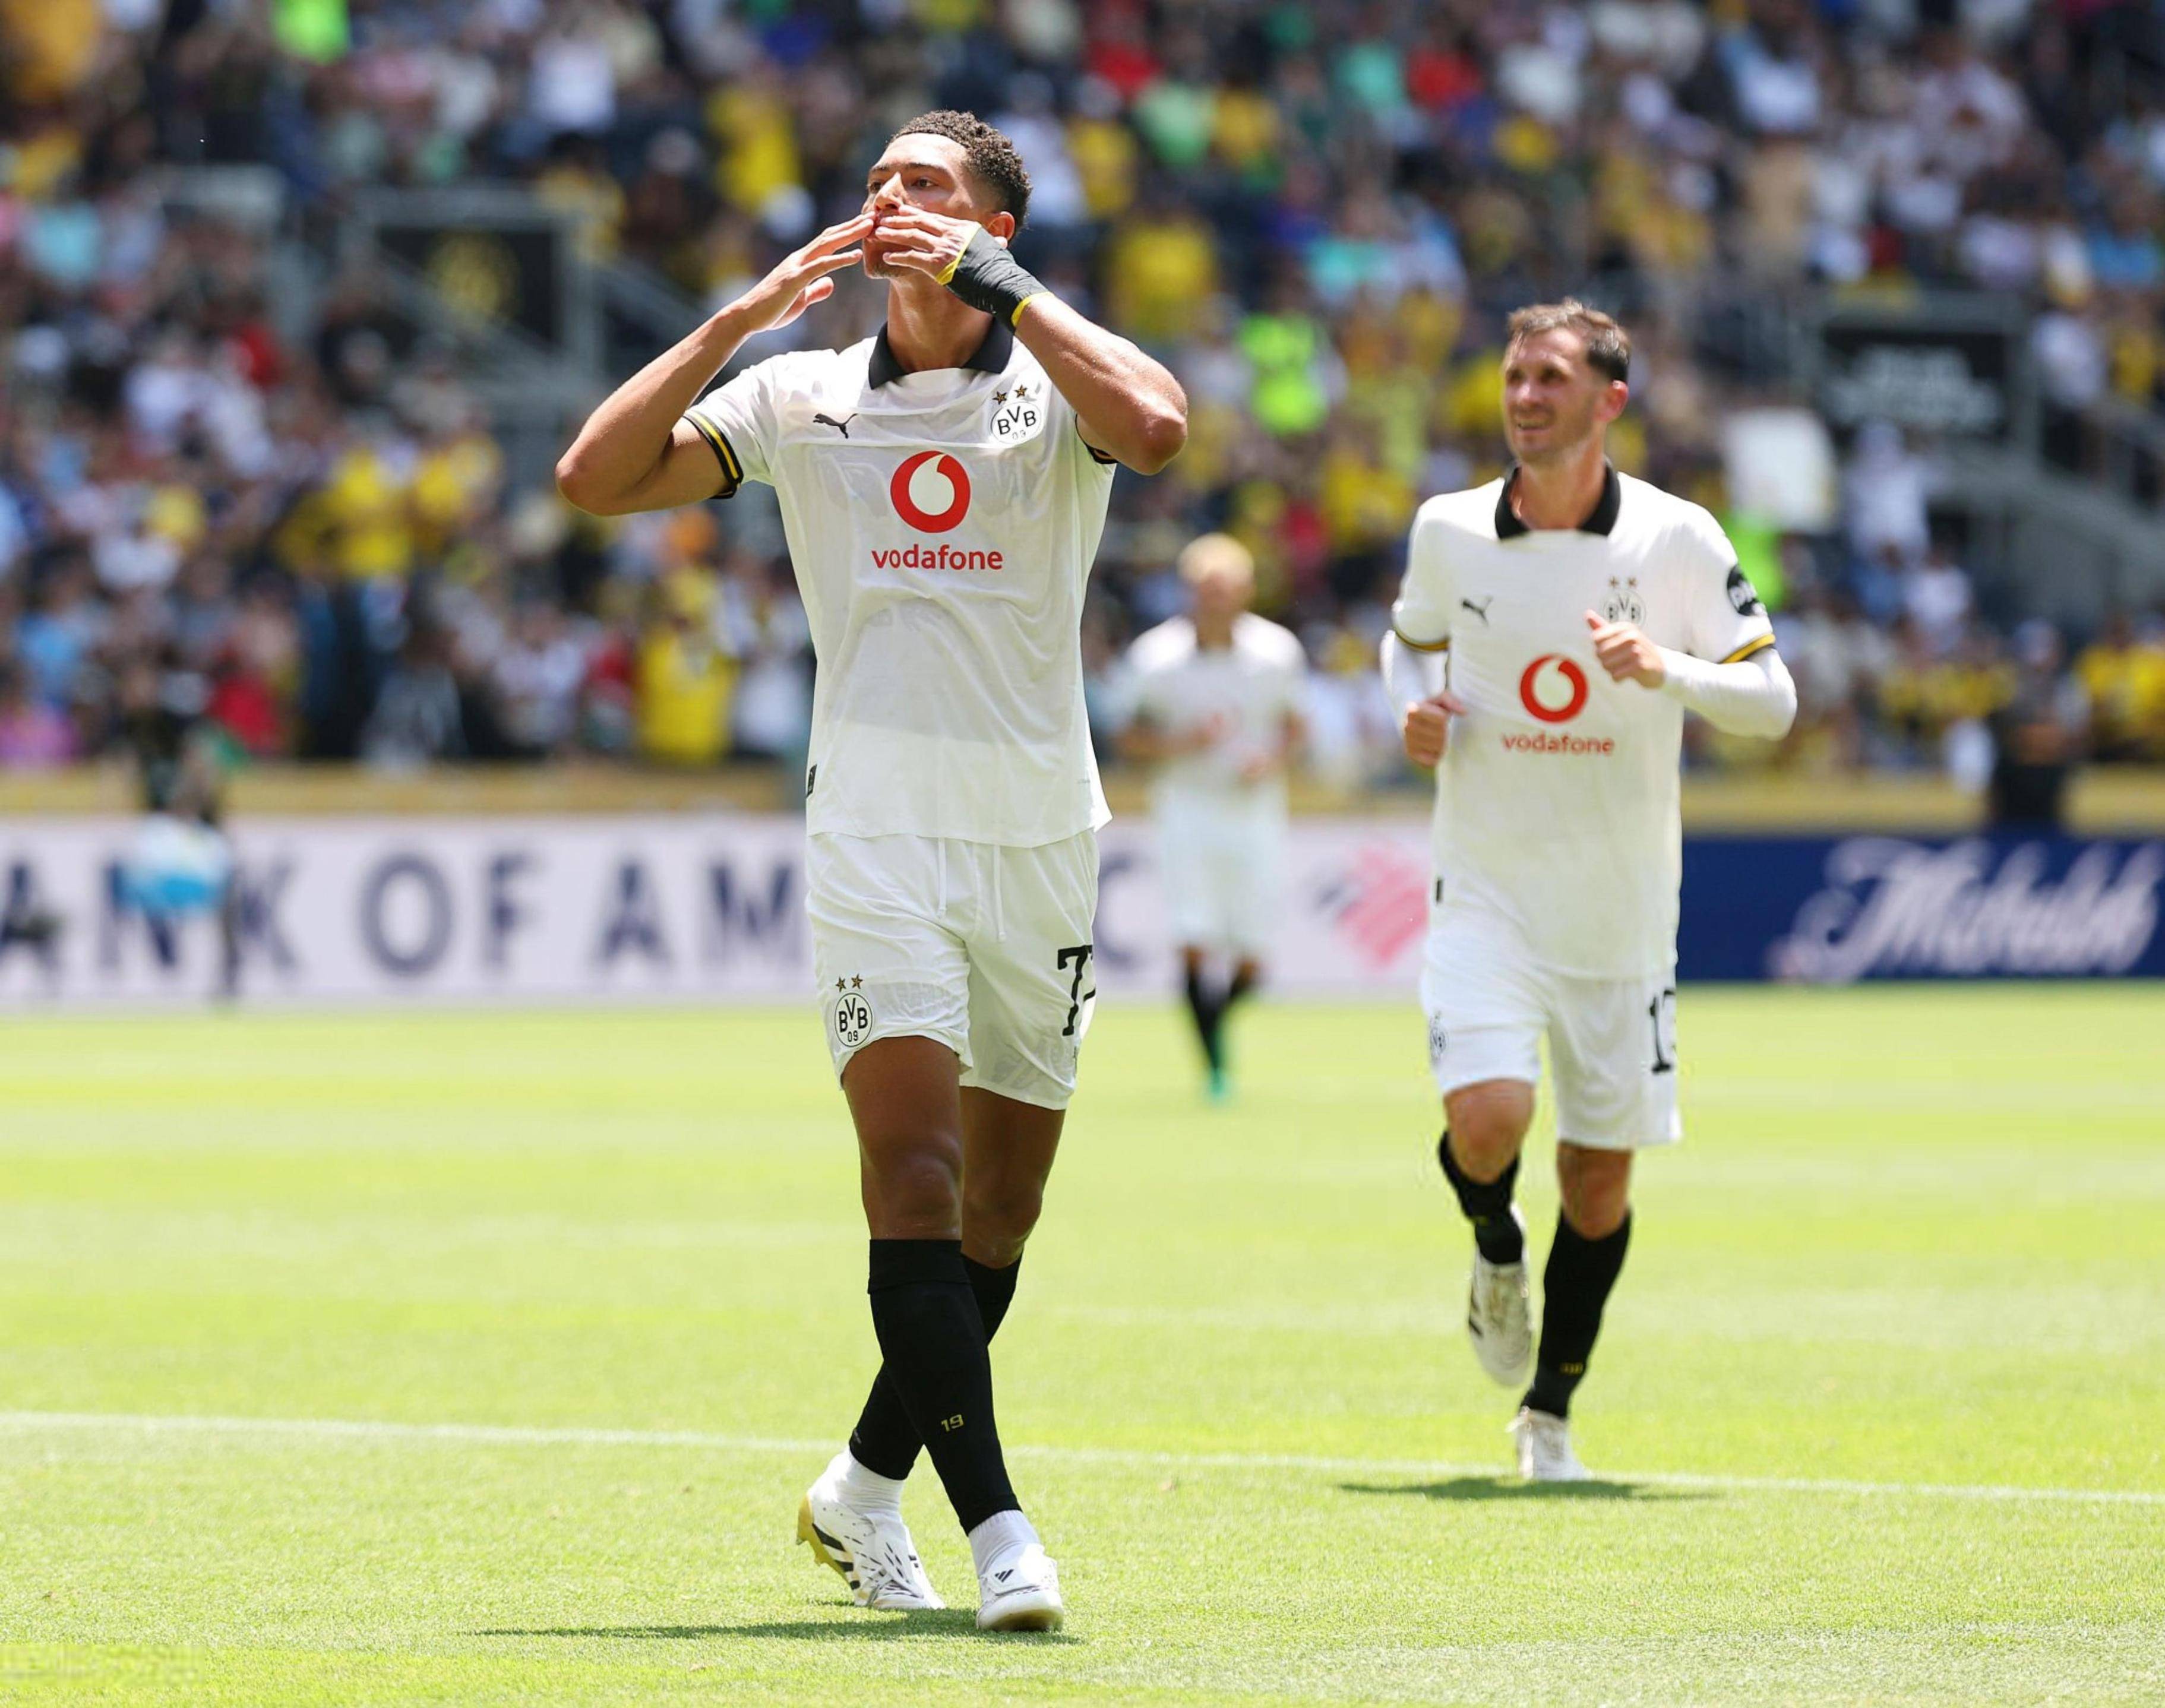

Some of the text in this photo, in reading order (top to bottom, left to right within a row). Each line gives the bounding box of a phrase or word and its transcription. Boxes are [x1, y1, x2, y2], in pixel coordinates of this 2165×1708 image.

[997, 406, 1036, 435] BVB
[871, 543, 1004, 570] vodafone
[1502, 732, 1615, 755] vodafone
[358, 852, 539, 978] OF
[1058, 945, 1096, 1036] 7
[839, 998, 868, 1033] BVB
[848, 1030, 858, 1042] 09
[941, 1414, 963, 1432] 19
